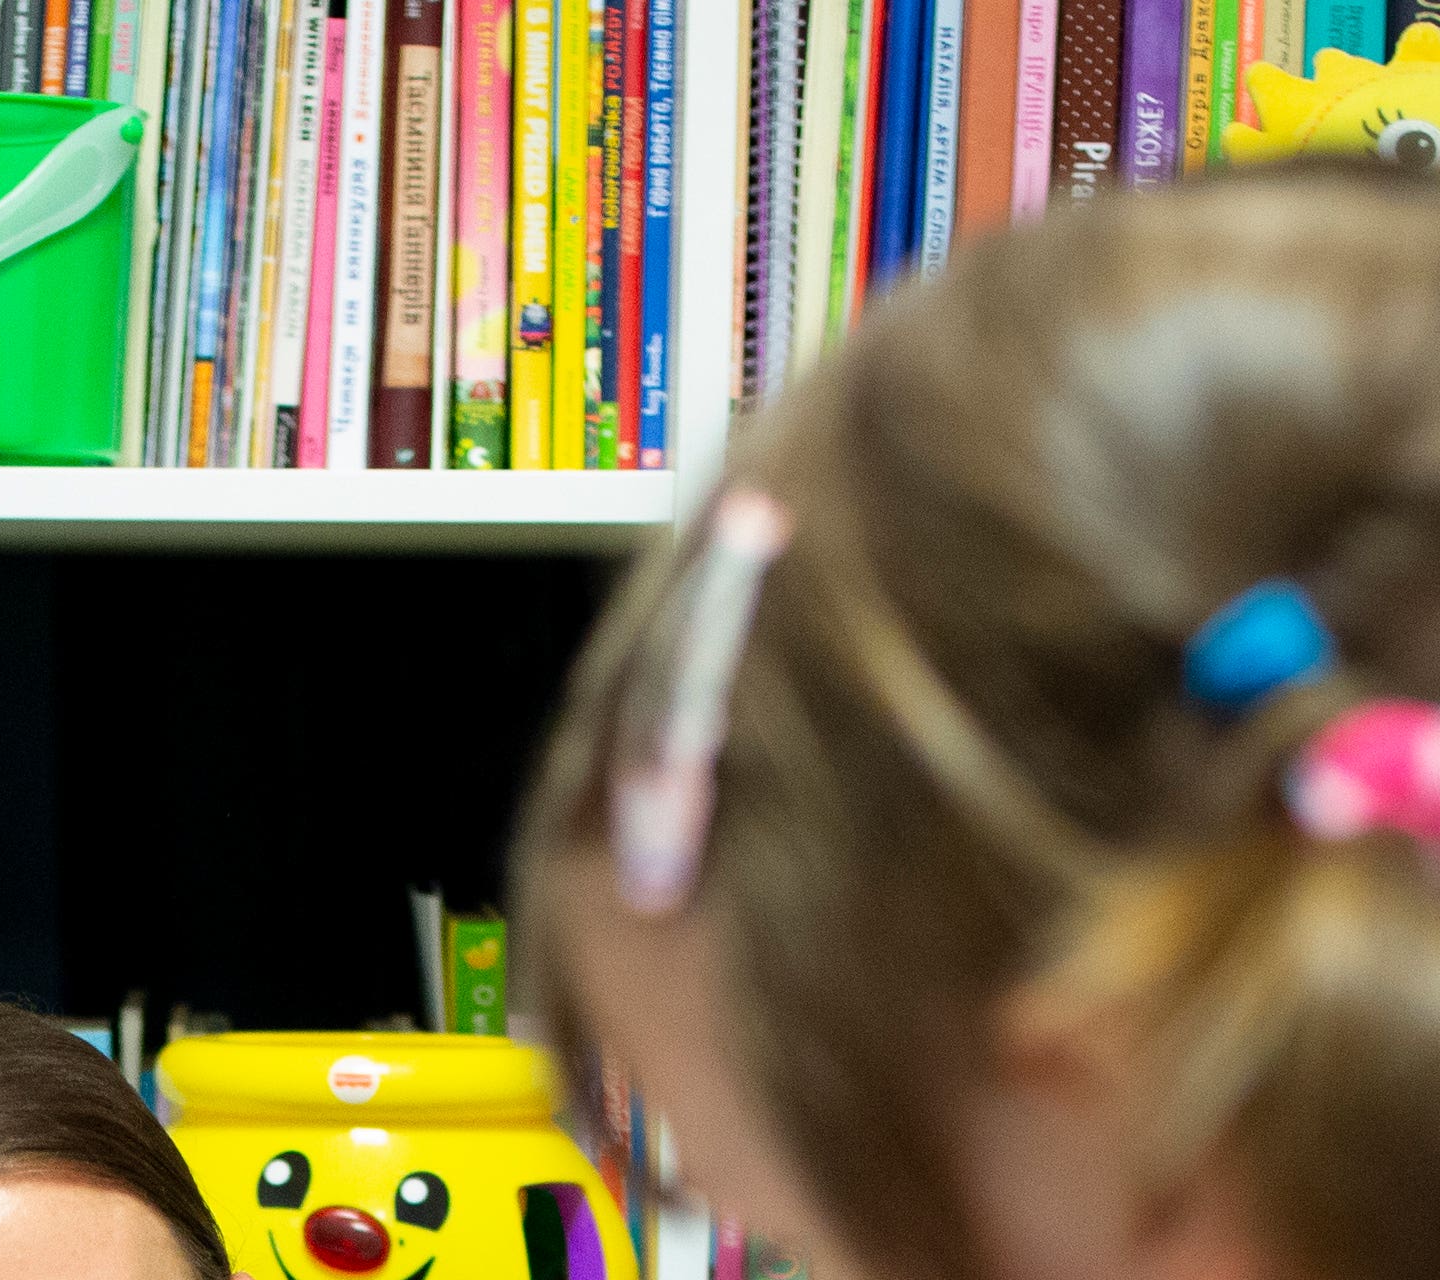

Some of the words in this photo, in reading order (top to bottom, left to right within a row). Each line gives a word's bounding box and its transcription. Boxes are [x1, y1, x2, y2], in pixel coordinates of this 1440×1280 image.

[524, 31, 548, 112] MINUT
[605, 6, 624, 90] POJAZDY
[931, 26, 956, 115] НАТАЛІЯ,
[403, 71, 433, 207] Таємниця
[1134, 92, 1164, 167] БОЖЕ?
[1188, 73, 1210, 151] Острів
[524, 117, 548, 198] PRZED
[603, 95, 622, 229] Kolorowanka
[523, 203, 548, 273] SNEM
